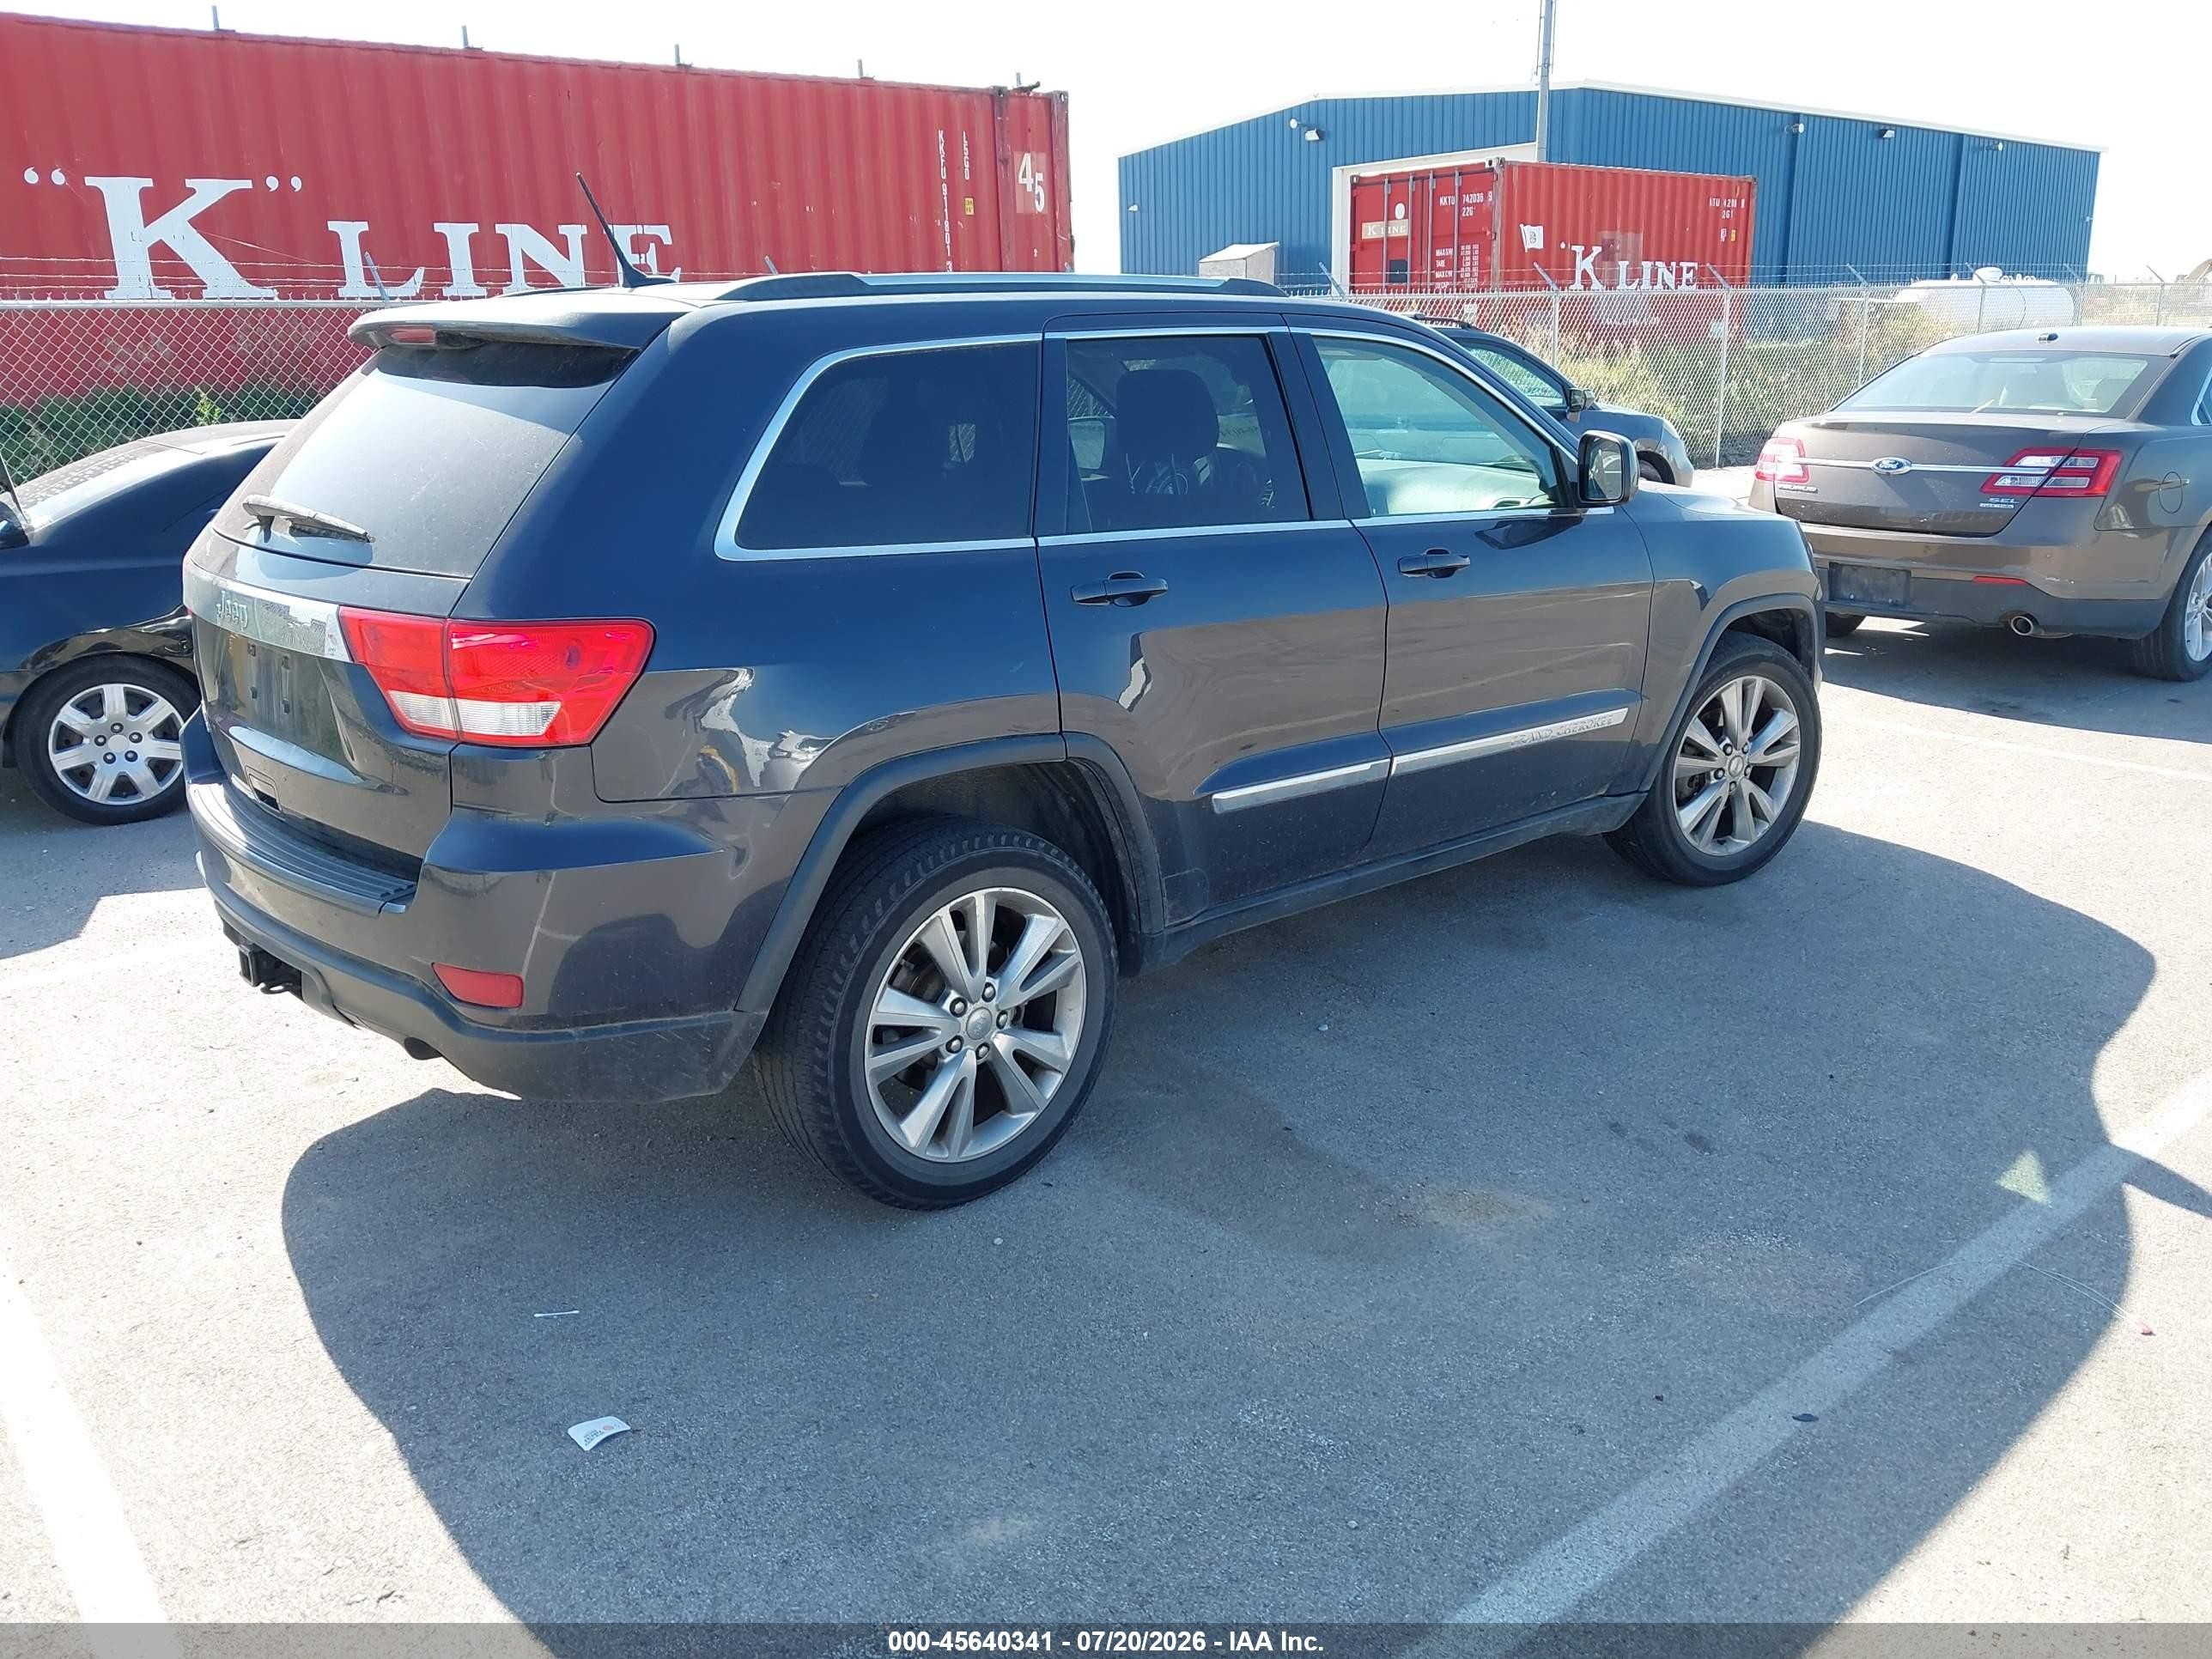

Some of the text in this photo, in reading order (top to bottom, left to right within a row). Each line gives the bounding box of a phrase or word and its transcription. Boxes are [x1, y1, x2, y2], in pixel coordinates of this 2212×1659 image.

[1018, 152, 1045, 212] 45
[1439, 190, 1493, 206] KKTU 742036 9
[327, 220, 682, 298] LINE
[1616, 260, 1698, 290] LINE
[216, 589, 248, 633] Jeep
[1510, 714, 1614, 747] GRAND CHEROKEE
